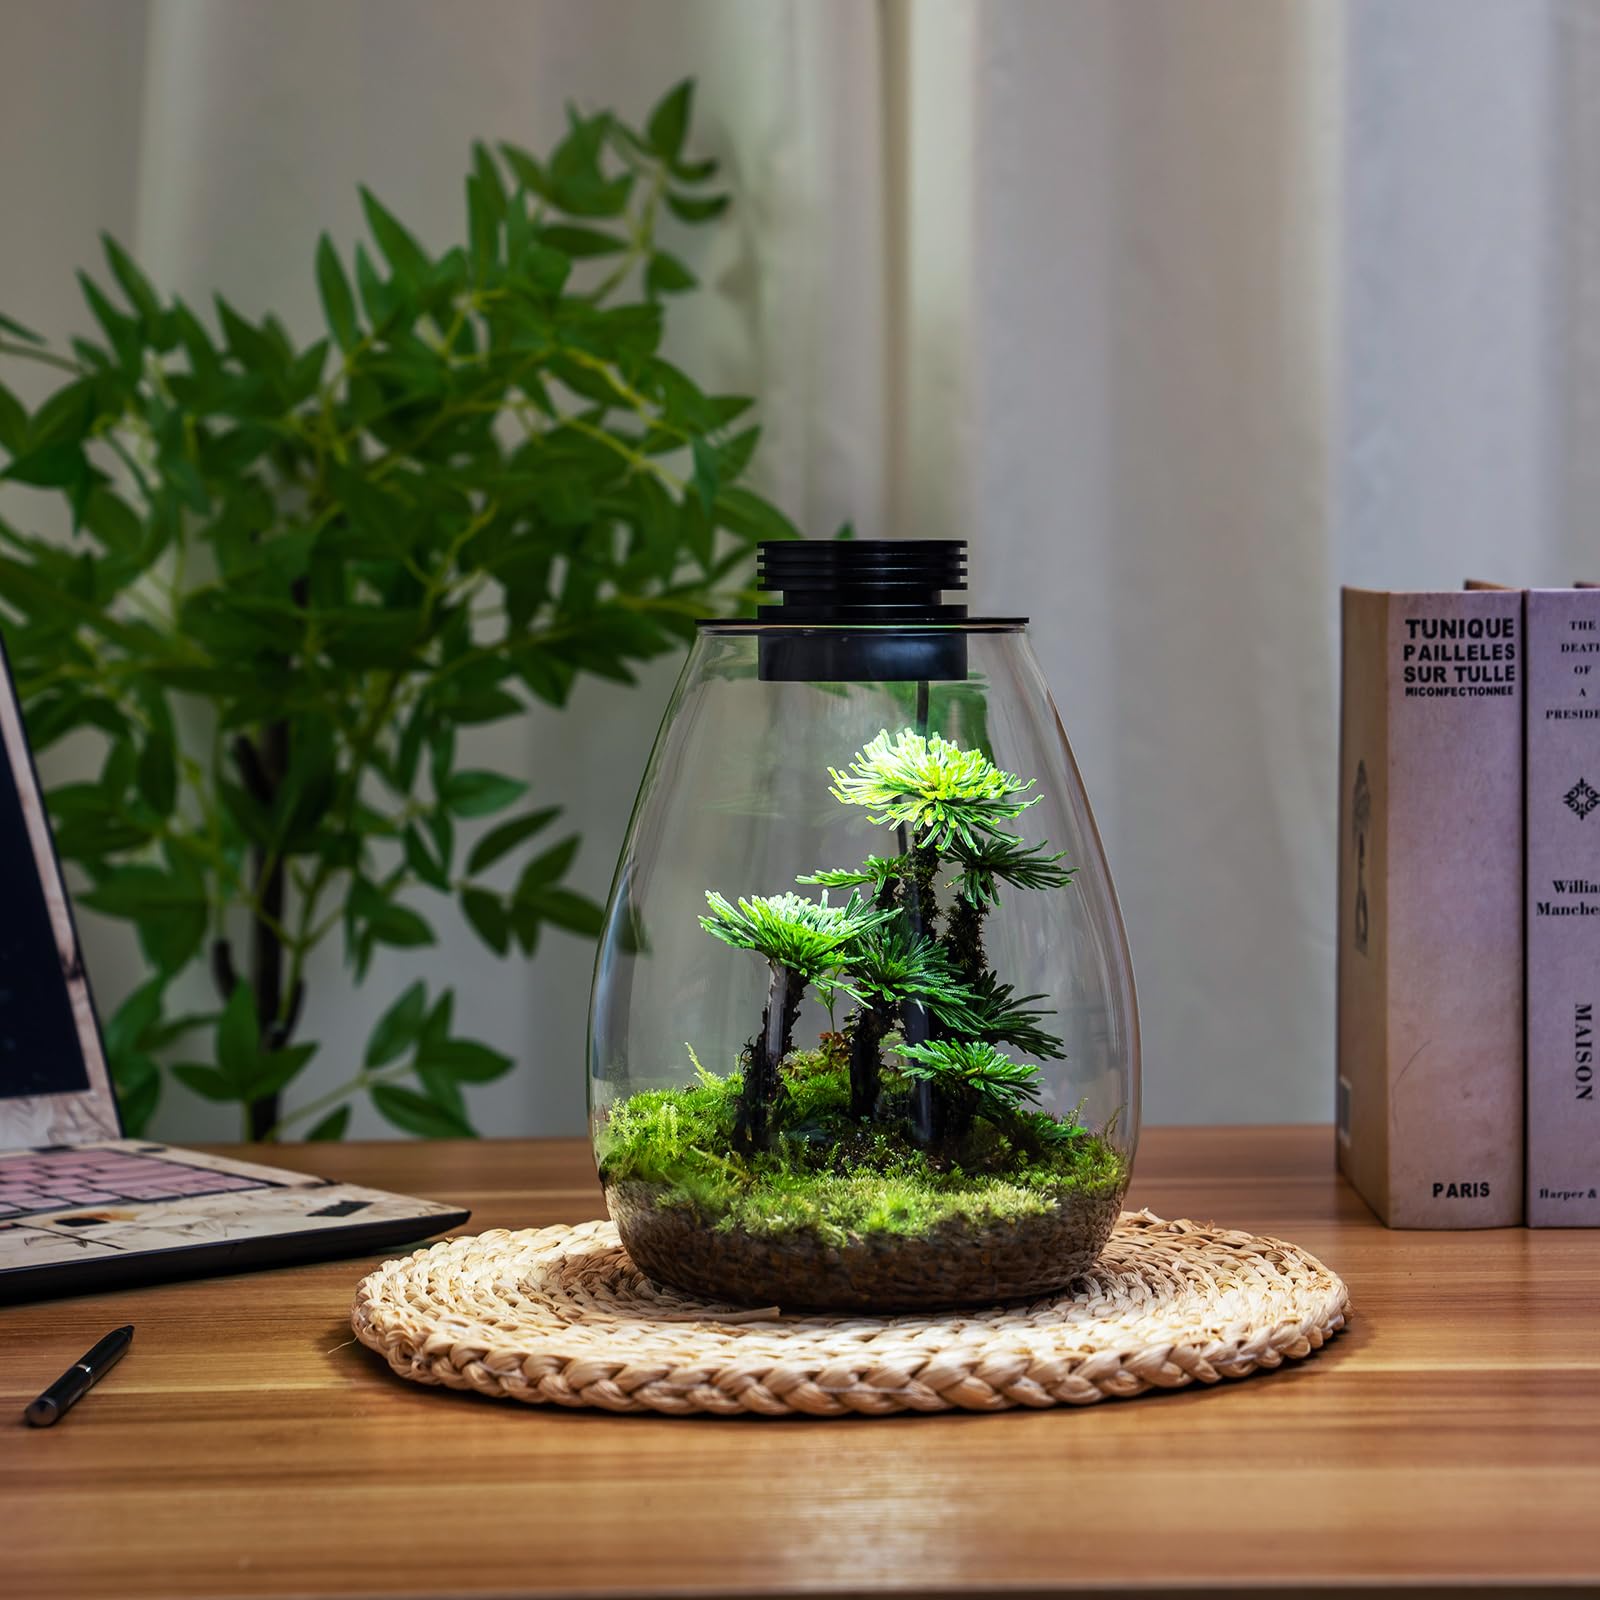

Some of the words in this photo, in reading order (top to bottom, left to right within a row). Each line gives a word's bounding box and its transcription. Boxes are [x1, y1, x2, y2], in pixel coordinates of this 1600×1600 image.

[1405, 618, 1515, 639] TUNIQUE
[1569, 621, 1596, 631] THE
[1403, 643, 1516, 661] PAILLELES
[1403, 666, 1447, 684] SUR
[1454, 665, 1516, 683] TULLE
[1574, 665, 1592, 675] OF
[1405, 685, 1515, 696] MICONFECTIONNEE
[1579, 687, 1587, 697] A
[1574, 1004, 1594, 1101] MAISON
[1432, 1182, 1490, 1198] PARIS
[1540, 1189, 1585, 1201] Harper
